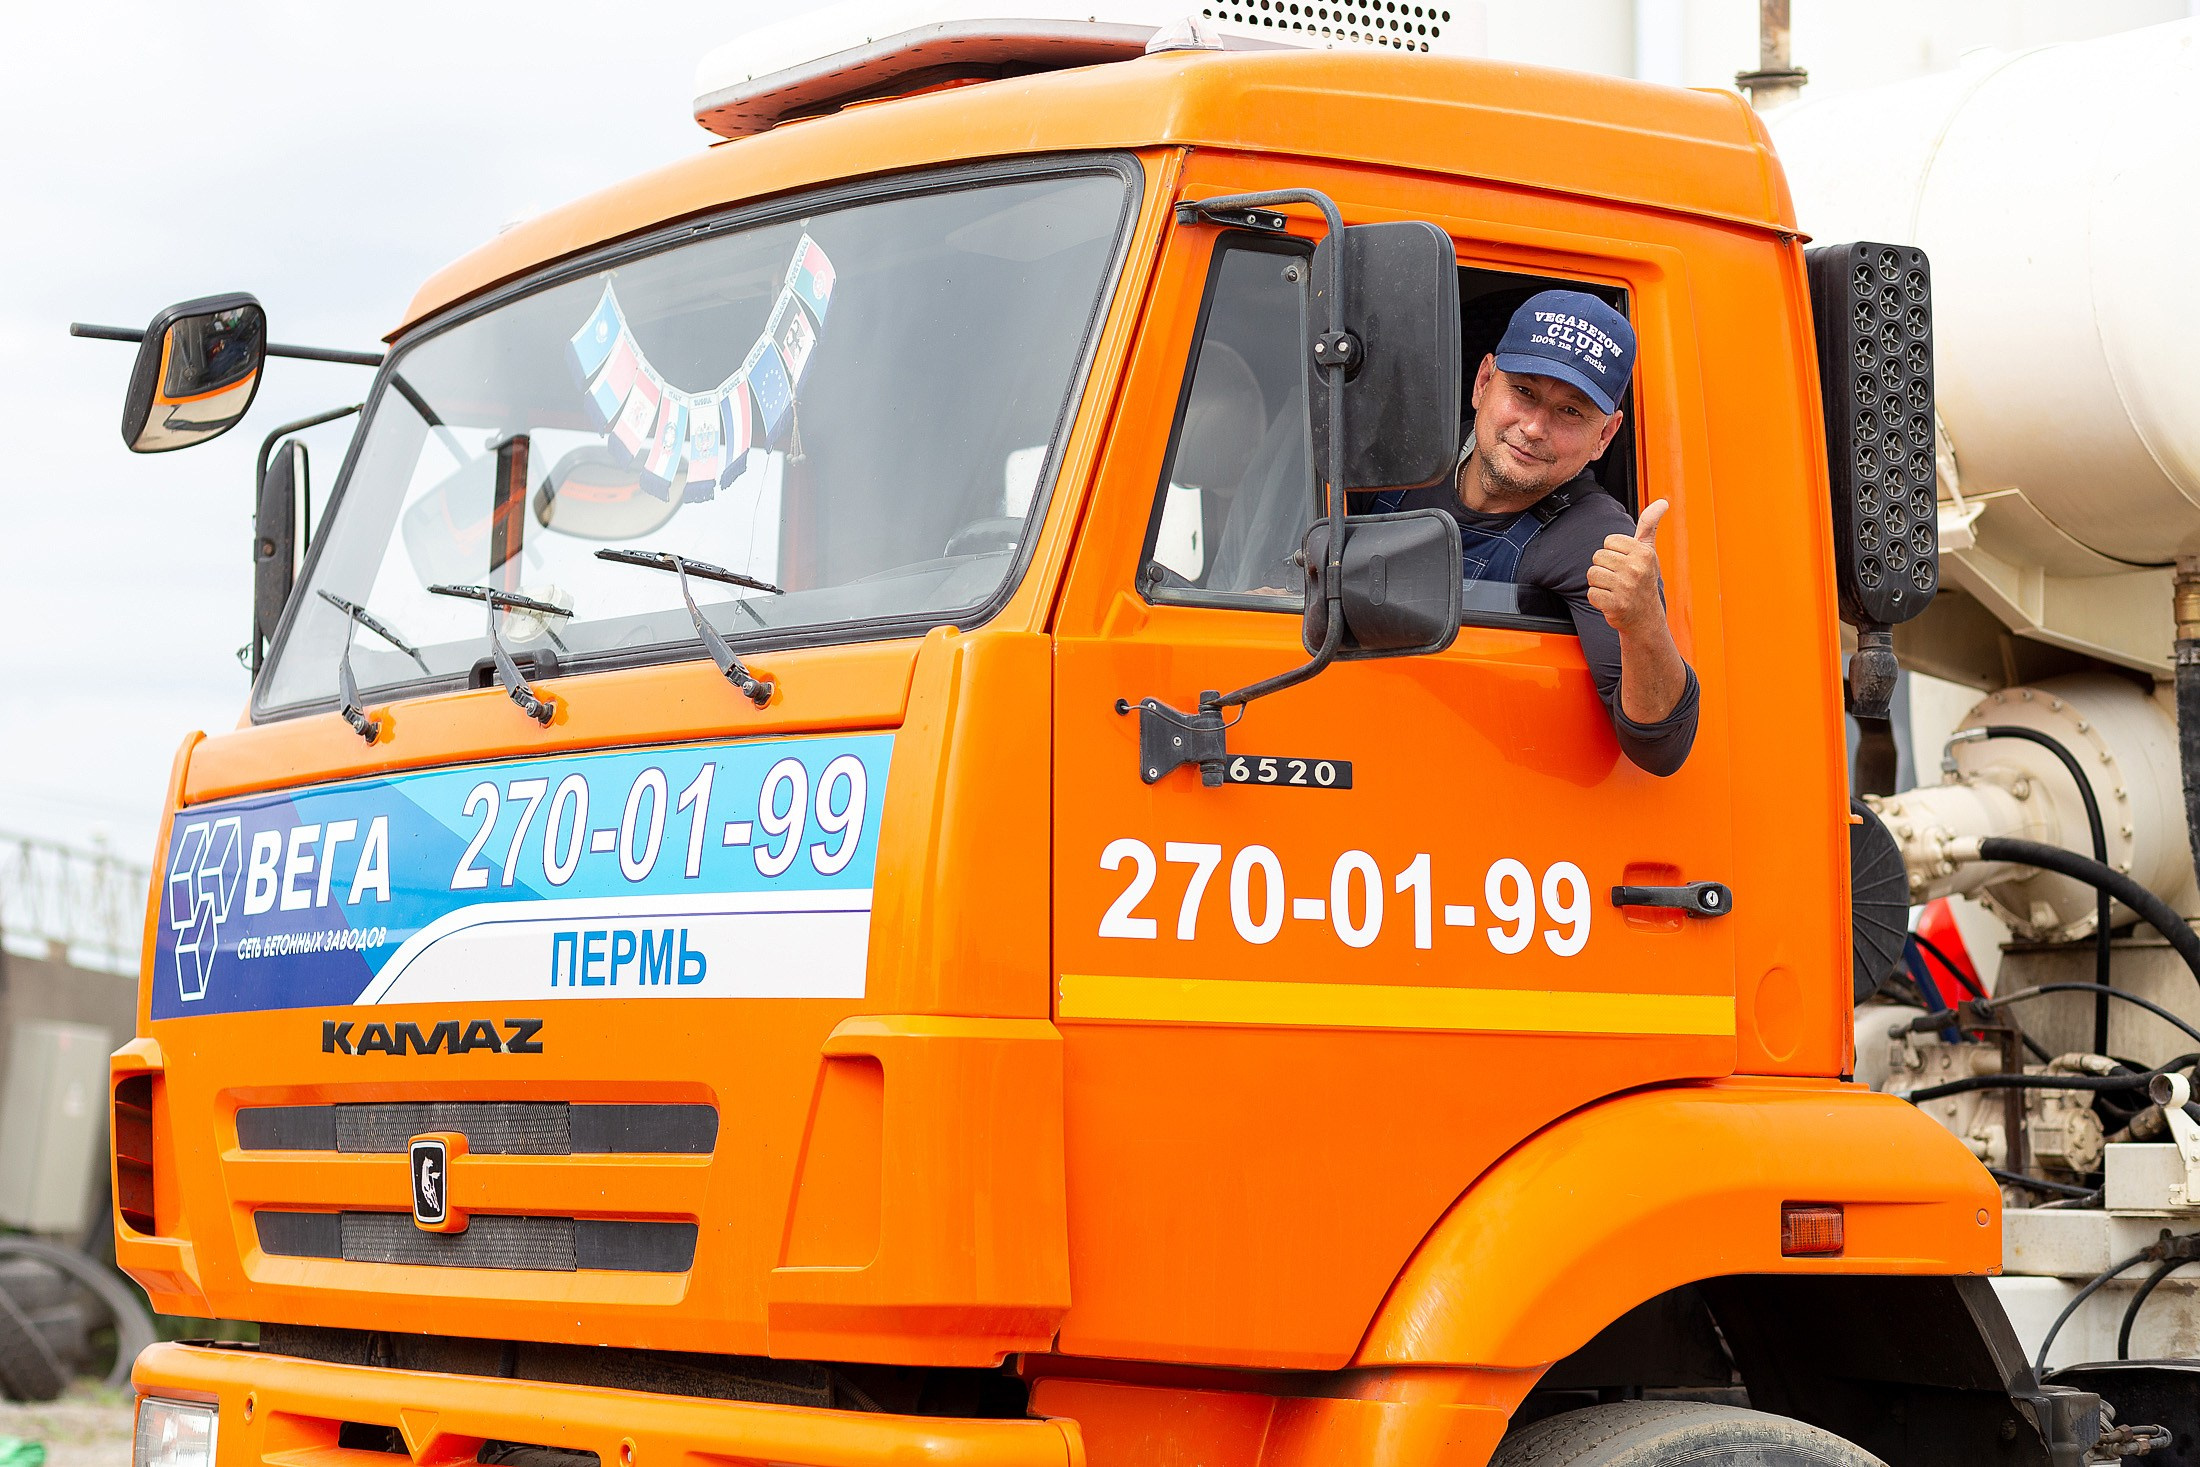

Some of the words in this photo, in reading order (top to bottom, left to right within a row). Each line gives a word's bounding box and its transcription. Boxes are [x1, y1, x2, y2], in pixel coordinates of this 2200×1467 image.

[1530, 333, 1556, 346] 100%
[1557, 340, 1572, 351] na
[1574, 347, 1583, 356] 7
[1582, 354, 1607, 374] sutki
[1534, 311, 1623, 358] VEGABETON
[1547, 323, 1604, 359] CLUB
[1229, 756, 1337, 786] 6520
[450, 753, 868, 891] 270-01-99
[243, 814, 392, 915] ВЕГА
[1098, 837, 1592, 957] 270-01-99
[237, 937, 262, 960] СЕТЬ
[263, 930, 325, 958] БЕТОННЫХ
[324, 927, 387, 952] ЗАВОДОВ
[550, 927, 708, 987] ПЕРМЬ
[322, 1018, 544, 1056] KAMAZ
